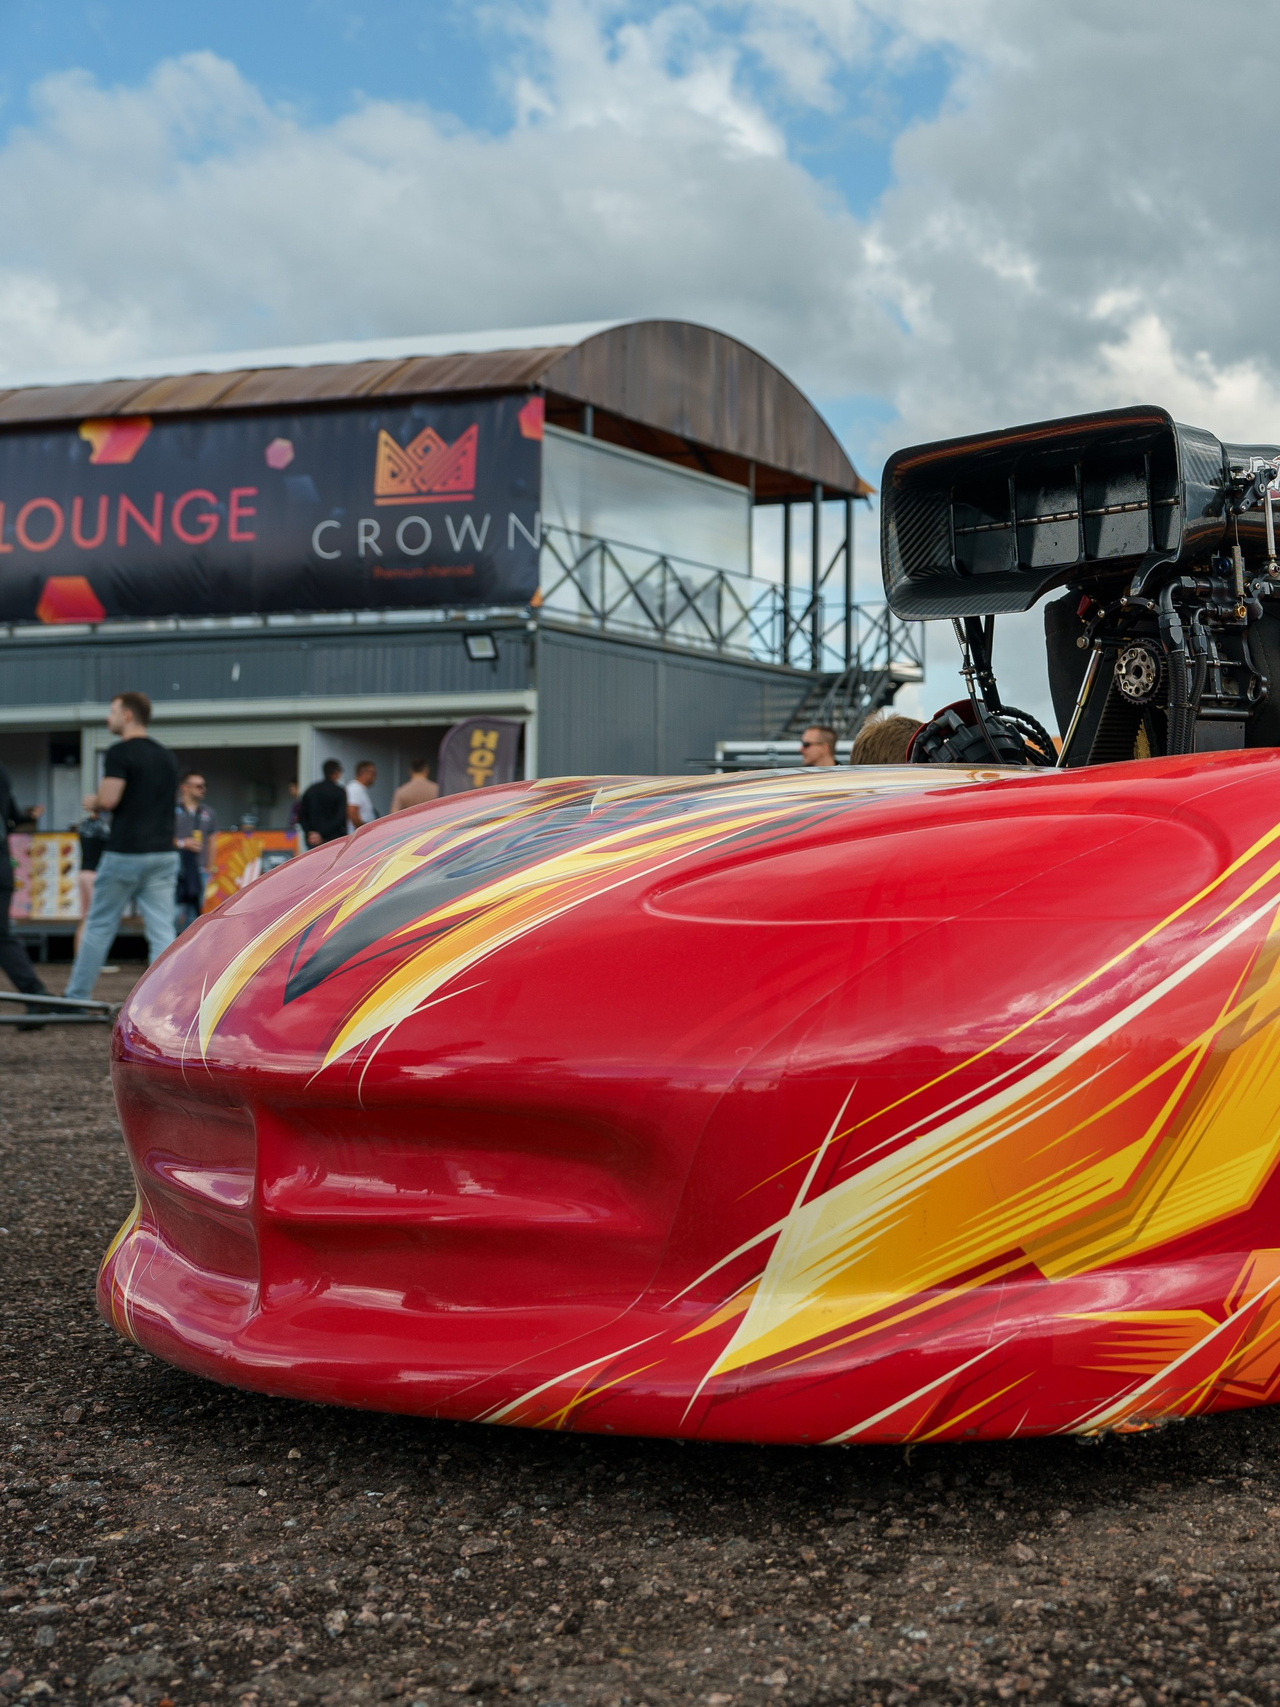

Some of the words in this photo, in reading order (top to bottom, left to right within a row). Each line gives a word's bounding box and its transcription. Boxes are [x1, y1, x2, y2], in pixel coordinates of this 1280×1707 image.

[0, 487, 258, 554] LOUNGE
[312, 511, 541, 560] CROWN
[466, 729, 498, 787] HOT
